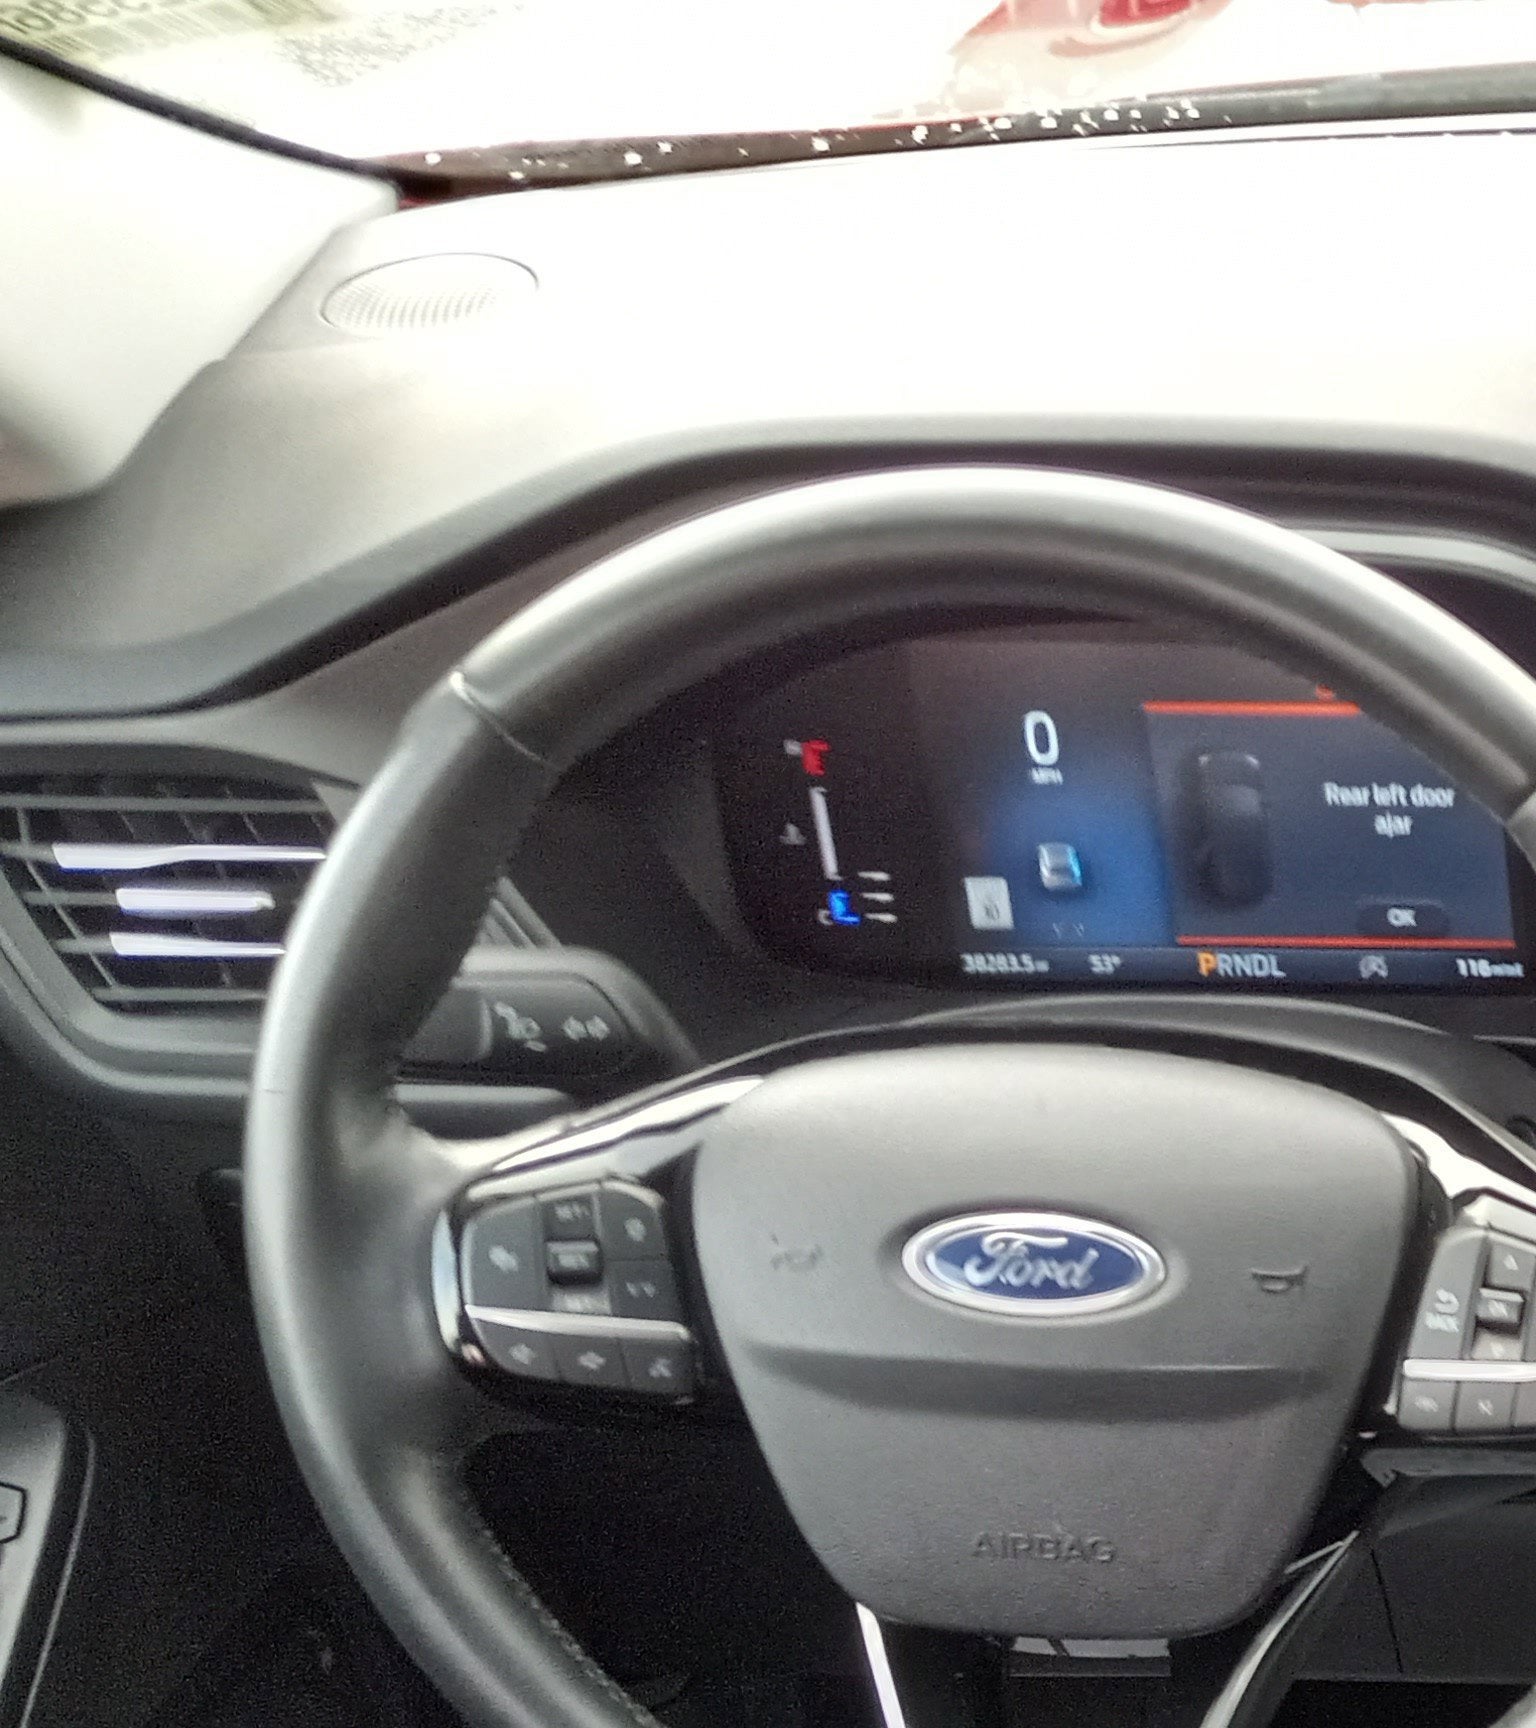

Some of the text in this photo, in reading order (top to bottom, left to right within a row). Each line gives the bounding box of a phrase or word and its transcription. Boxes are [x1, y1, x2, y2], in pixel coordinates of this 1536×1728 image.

[1024, 710, 1060, 766] 0
[1323, 781, 1455, 808] Rear left door
[1374, 810, 1412, 838] ajar
[1386, 908, 1417, 928] OK
[1197, 951, 1286, 979] PRNDL
[963, 1230, 1100, 1290] Ford
[973, 1530, 1116, 1563] AIRBAG
